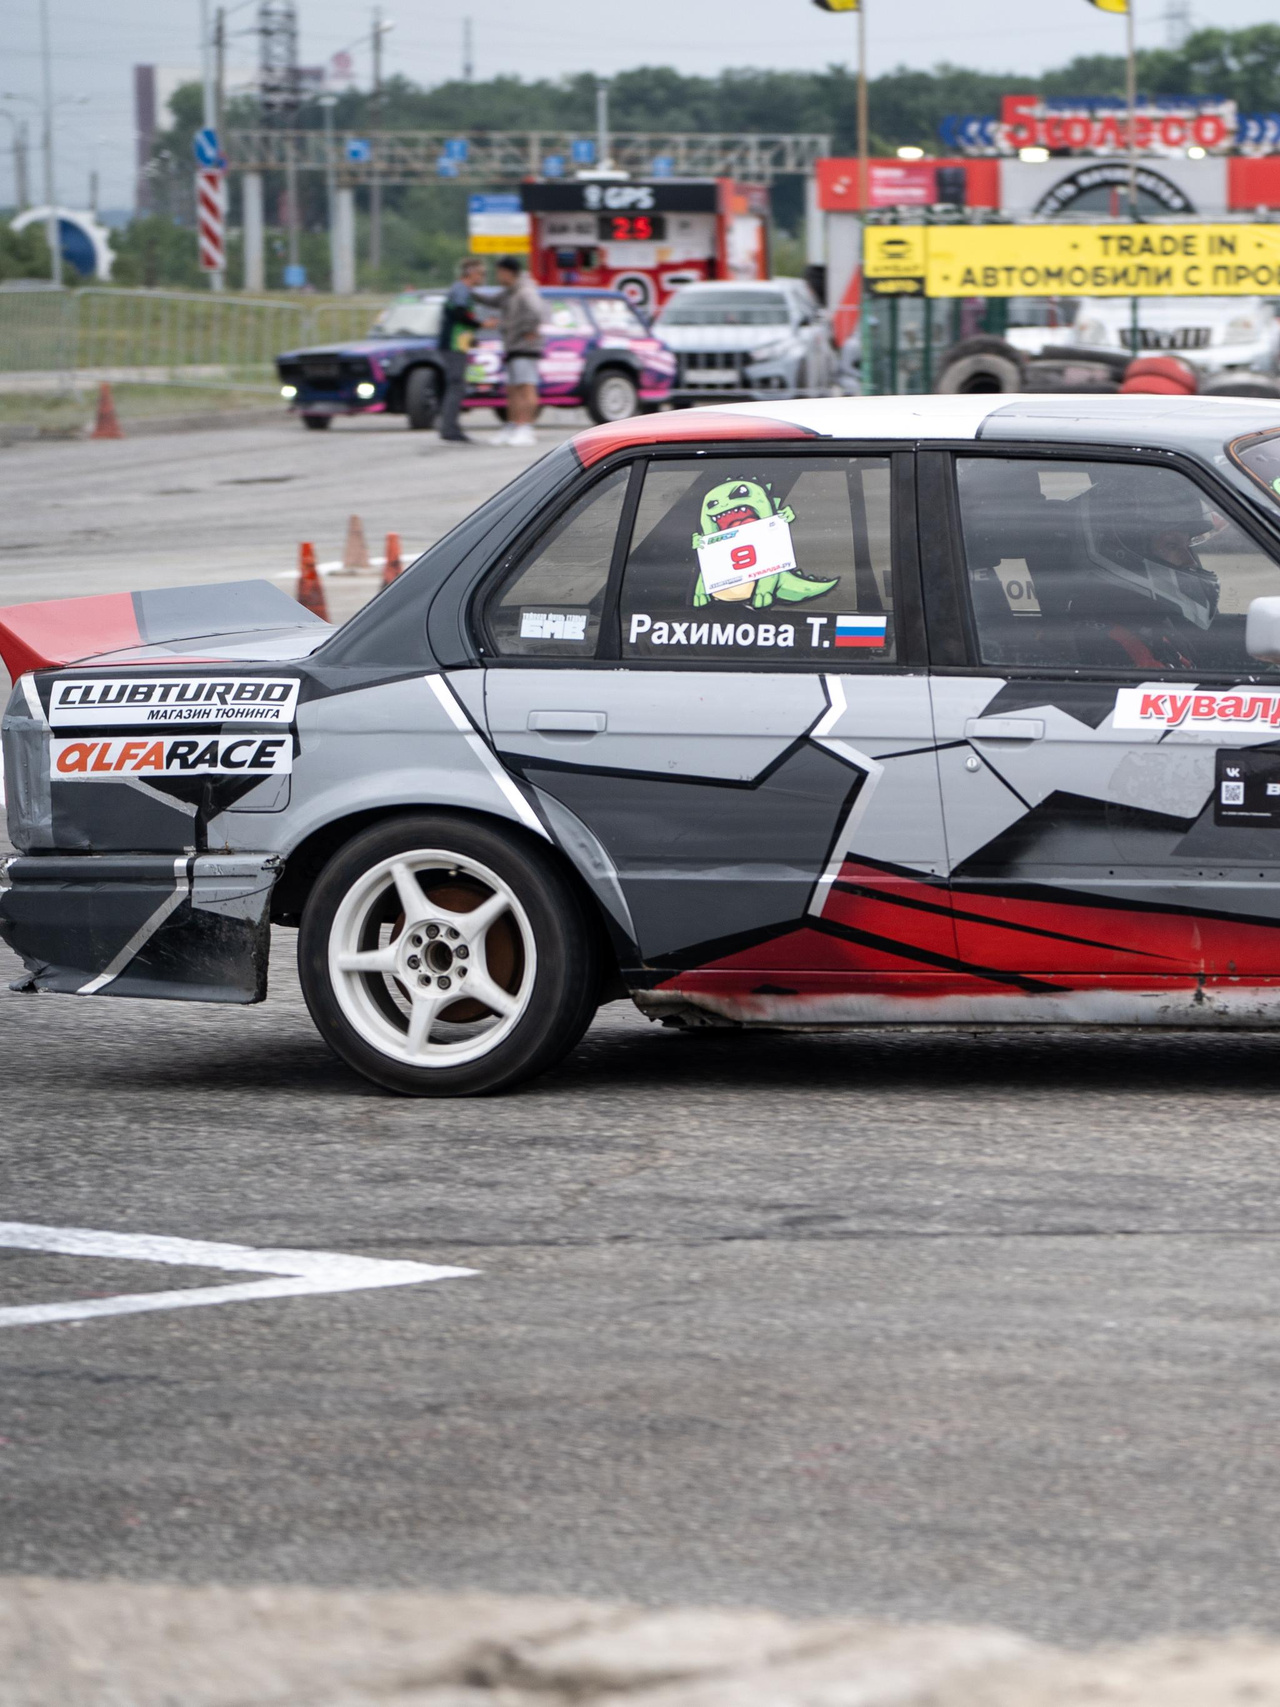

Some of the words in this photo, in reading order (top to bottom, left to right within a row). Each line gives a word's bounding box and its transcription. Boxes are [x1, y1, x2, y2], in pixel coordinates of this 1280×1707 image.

[1098, 235, 1198, 256] TRADE
[1207, 235, 1236, 256] IN
[960, 266, 1174, 288] АВТОМОБИЛИ
[1184, 265, 1201, 286] С
[731, 545, 757, 570] 9
[520, 619, 586, 640] БМВ
[629, 614, 795, 647] Рахимова
[806, 617, 830, 648] Т.
[58, 682, 293, 705] CLUBTURBO
[147, 709, 211, 720] МАГАЗИН
[215, 708, 280, 719] ТЮНИНГА
